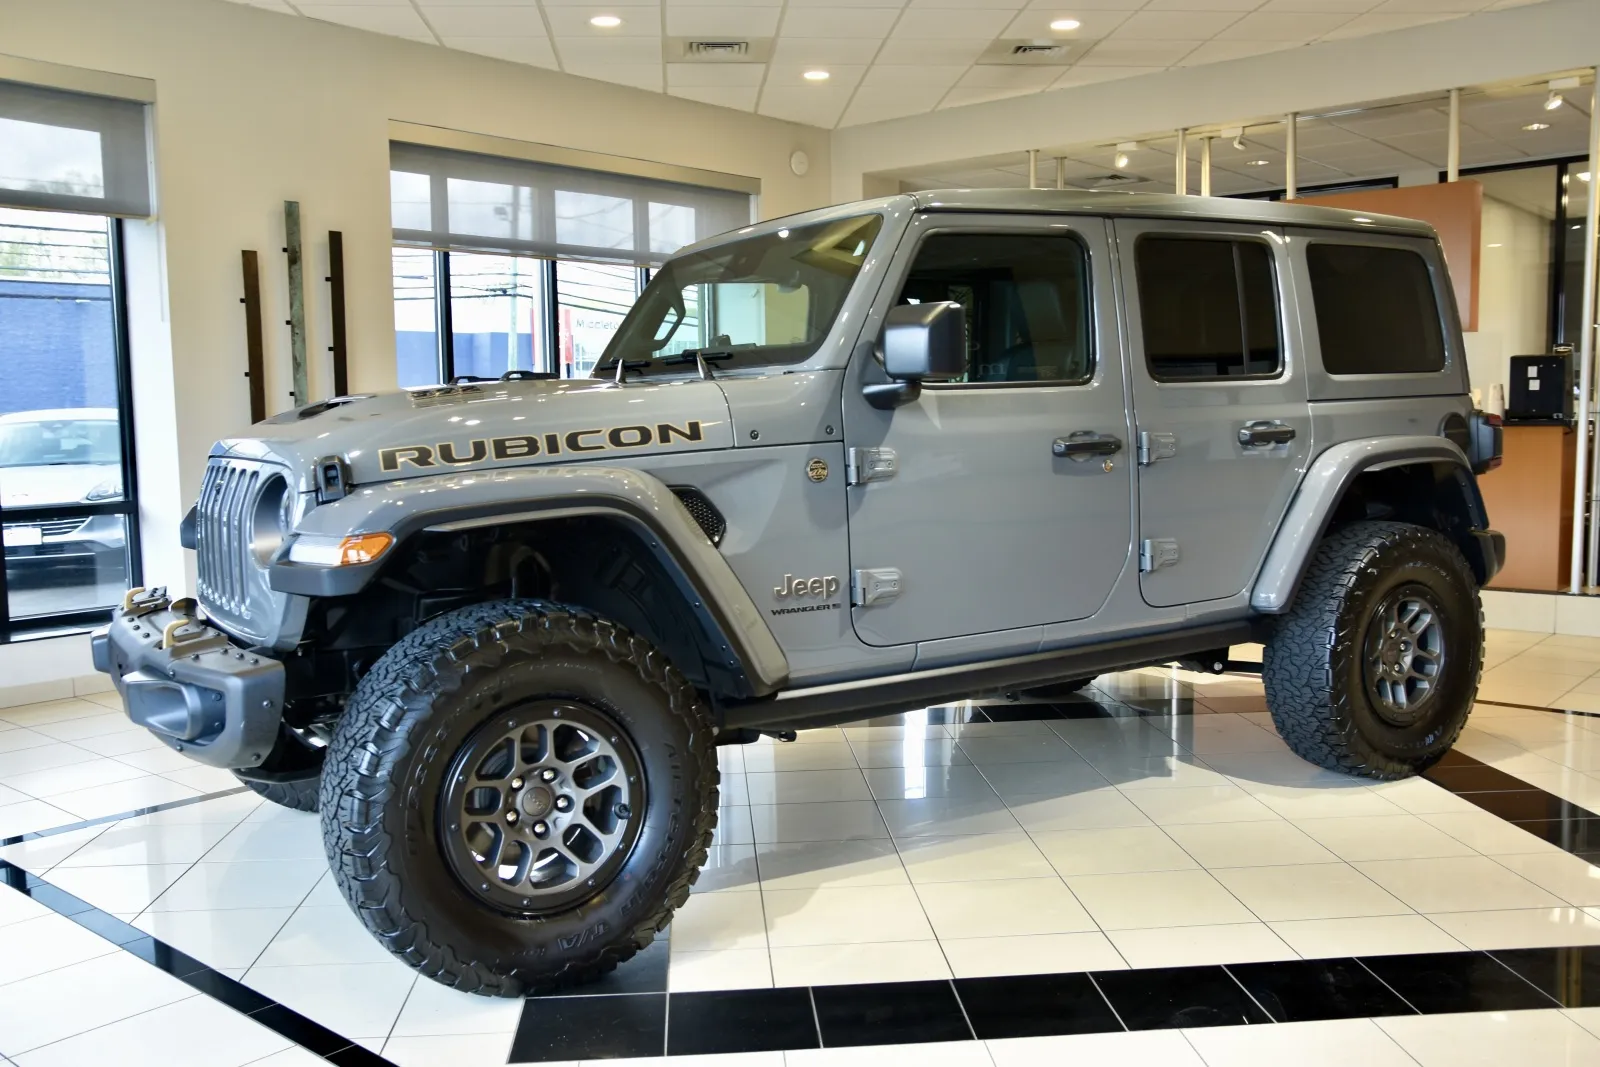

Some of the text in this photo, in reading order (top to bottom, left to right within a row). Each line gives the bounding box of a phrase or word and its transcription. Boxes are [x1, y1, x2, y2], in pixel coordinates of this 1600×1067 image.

[379, 420, 703, 472] RUBICON
[773, 573, 841, 600] Jeep
[771, 603, 831, 616] WRANGLER
